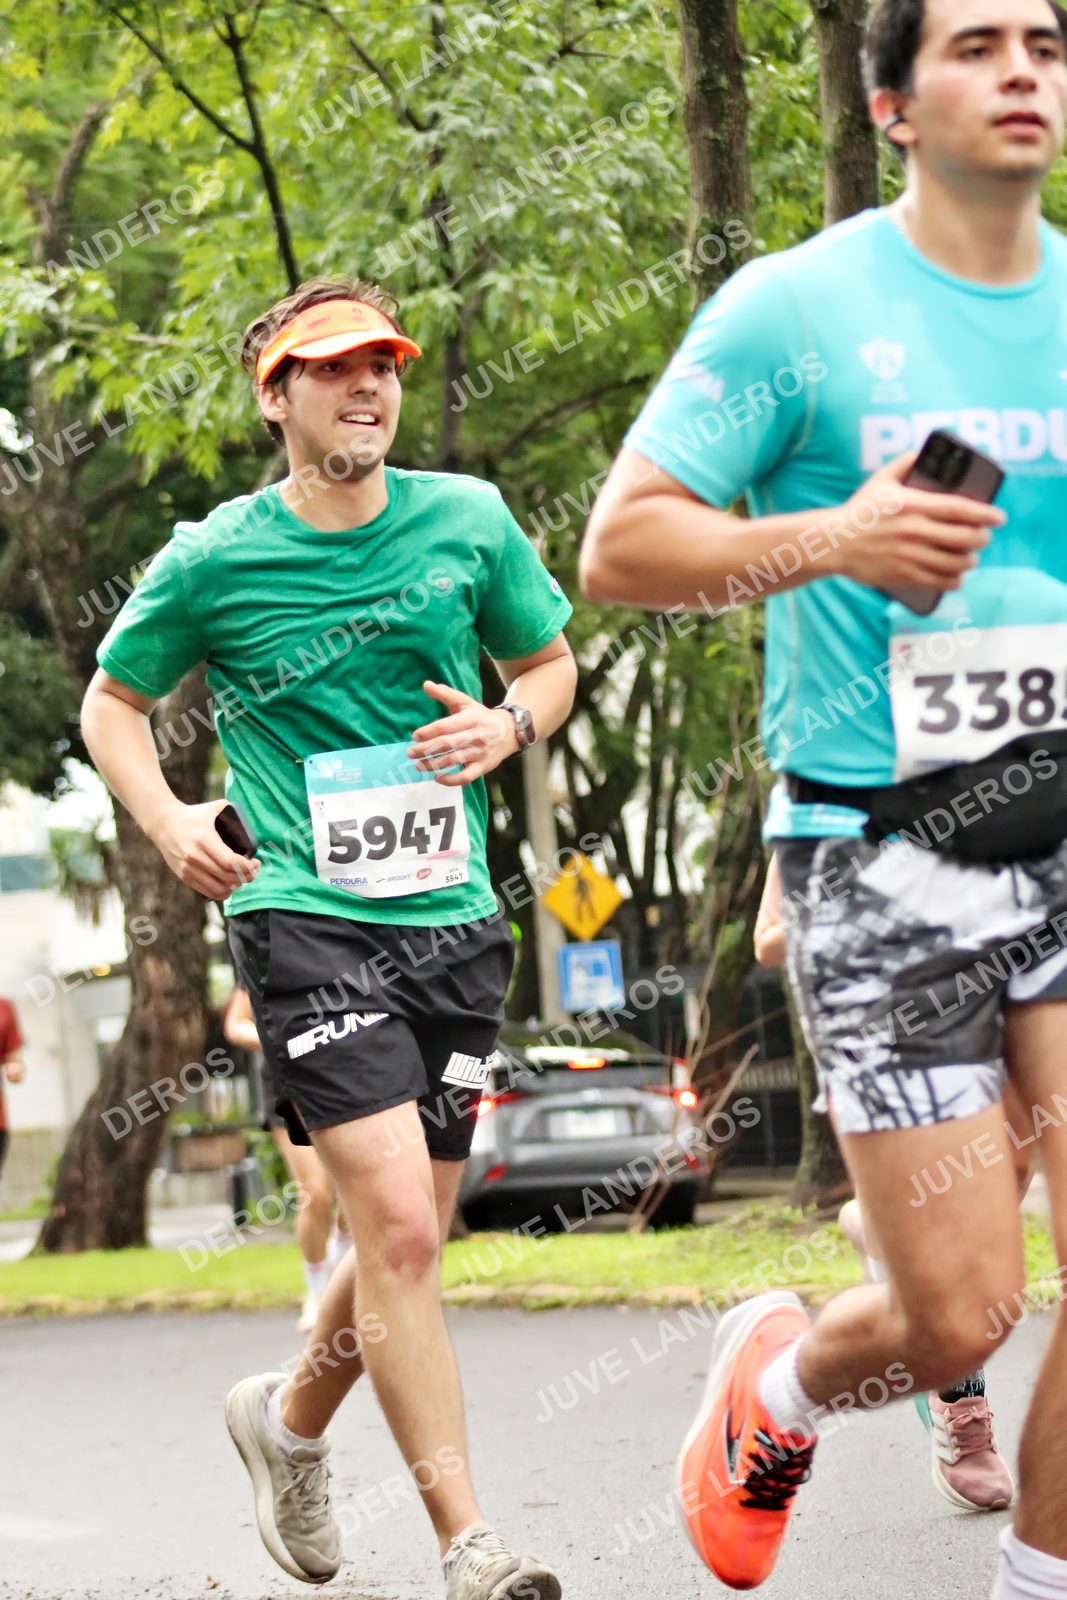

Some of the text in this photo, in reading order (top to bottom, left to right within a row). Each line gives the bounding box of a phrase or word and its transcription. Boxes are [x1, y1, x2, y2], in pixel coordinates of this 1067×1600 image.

[913, 667, 1067, 734] 338
[327, 805, 456, 864] 5947
[329, 876, 368, 885] PERDURA
[445, 872, 463, 883] 5947
[304, 1012, 372, 1052] RUN
